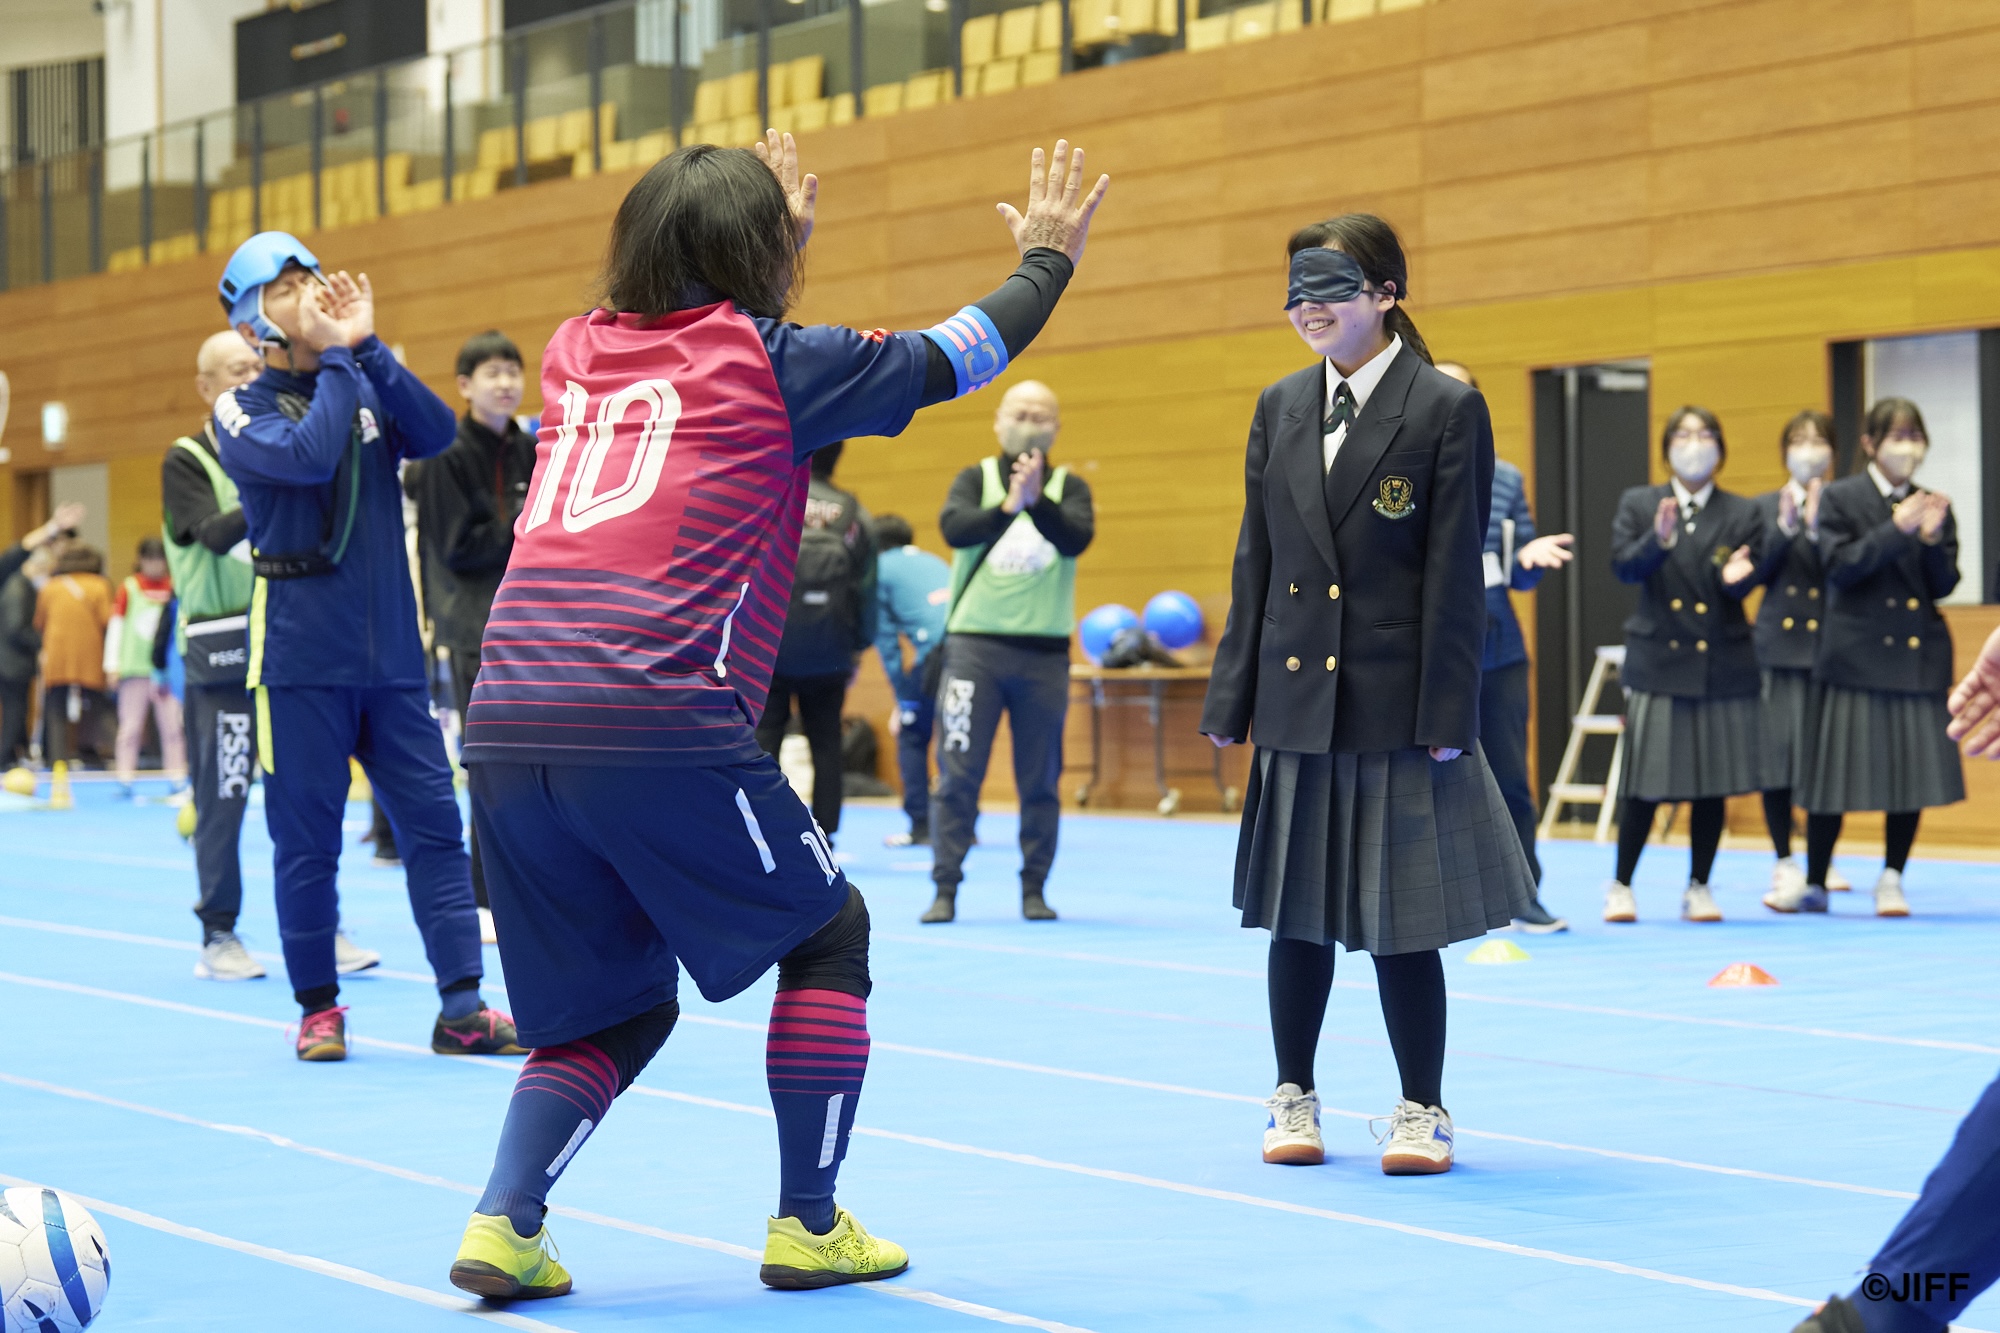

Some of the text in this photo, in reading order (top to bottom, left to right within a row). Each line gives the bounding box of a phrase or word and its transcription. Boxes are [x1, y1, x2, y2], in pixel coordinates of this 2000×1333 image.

[525, 379, 682, 534] 10
[223, 712, 249, 799] PSSC
[946, 679, 975, 753] PSSC
